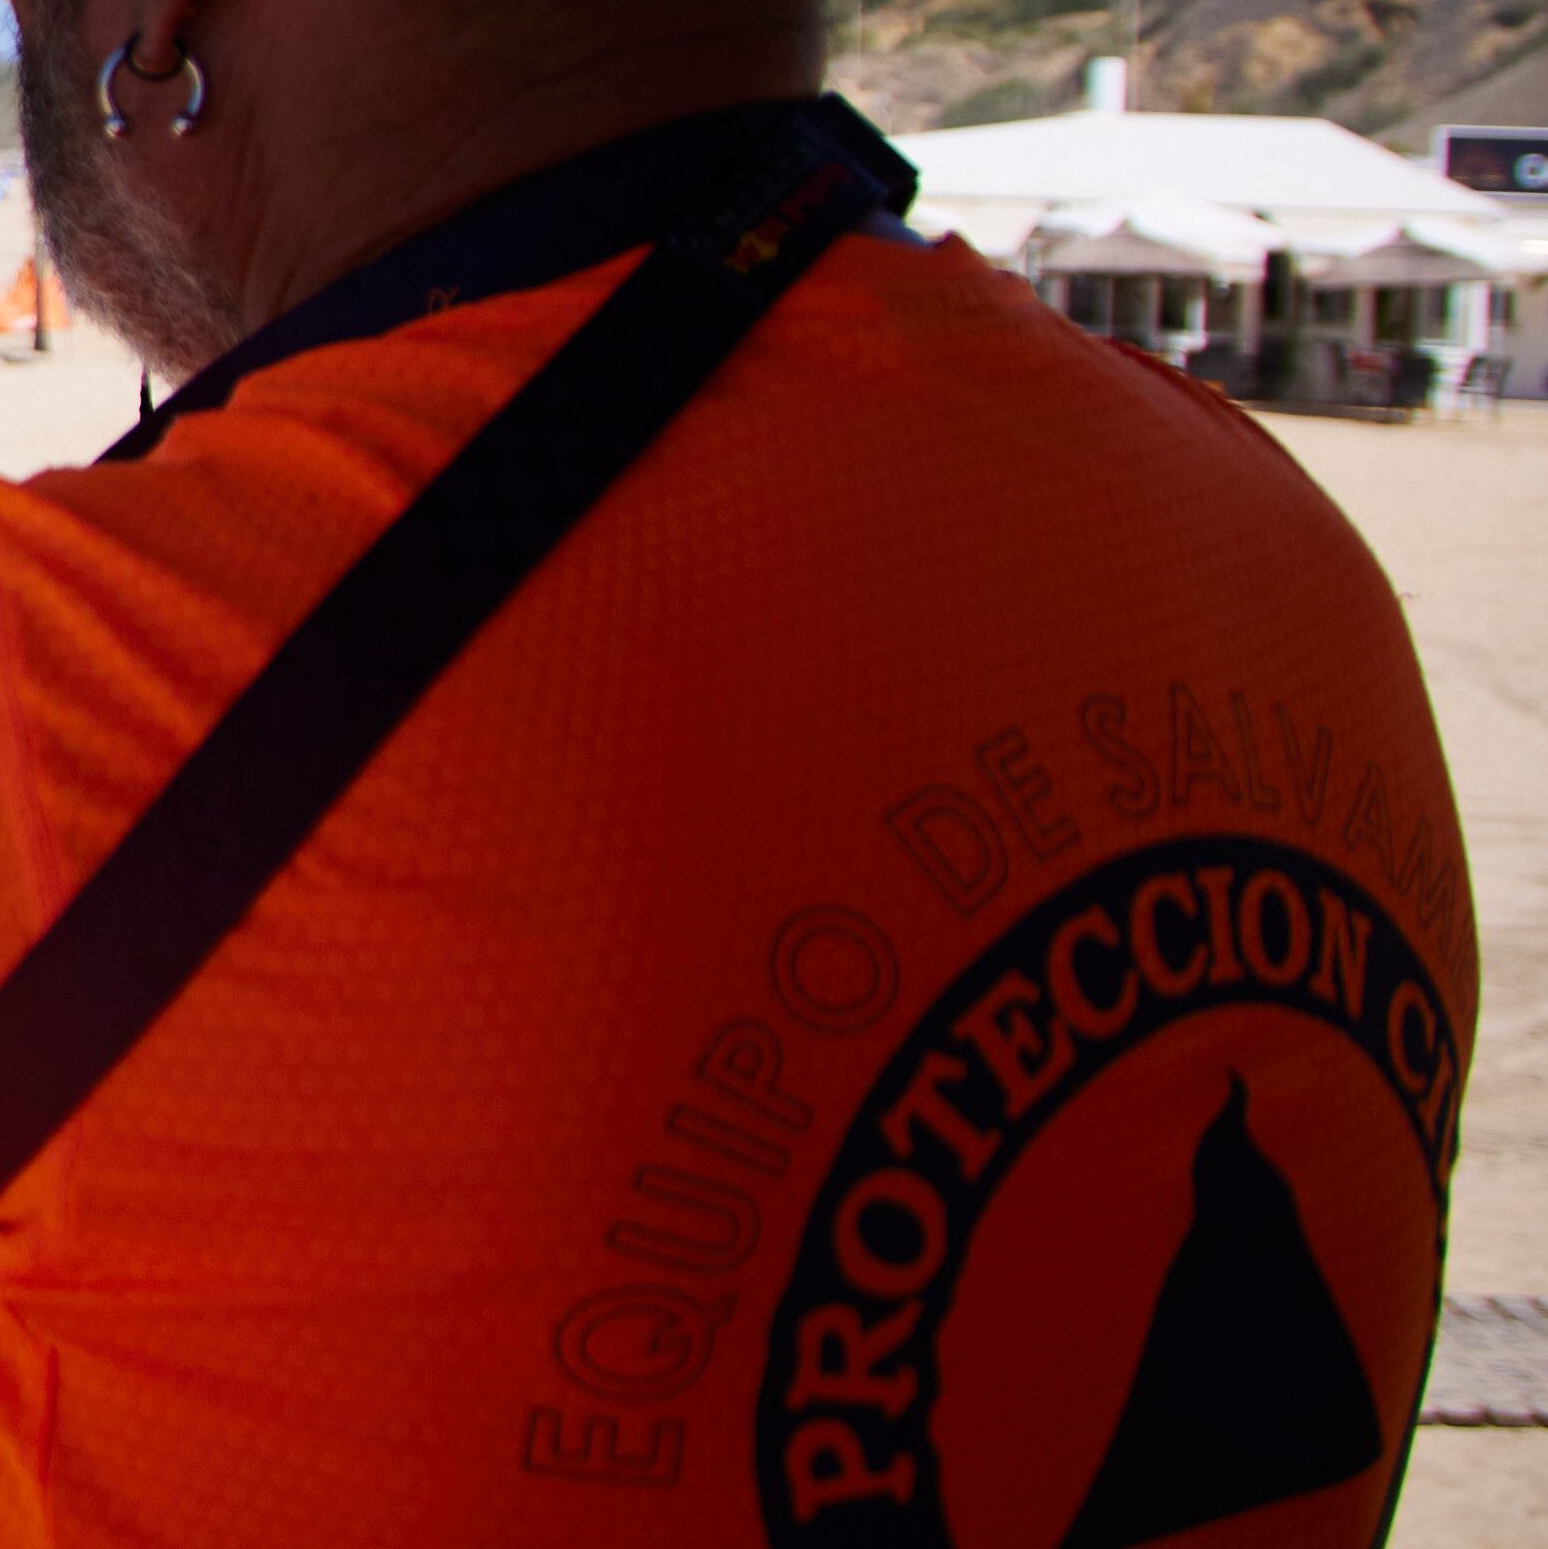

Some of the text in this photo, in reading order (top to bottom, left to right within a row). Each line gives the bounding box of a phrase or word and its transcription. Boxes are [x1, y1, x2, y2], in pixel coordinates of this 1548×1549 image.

[523, 902, 900, 1490] EQUIPO
[884, 725, 1082, 917] DE
[785, 864, 1373, 1523] PROTECCION
